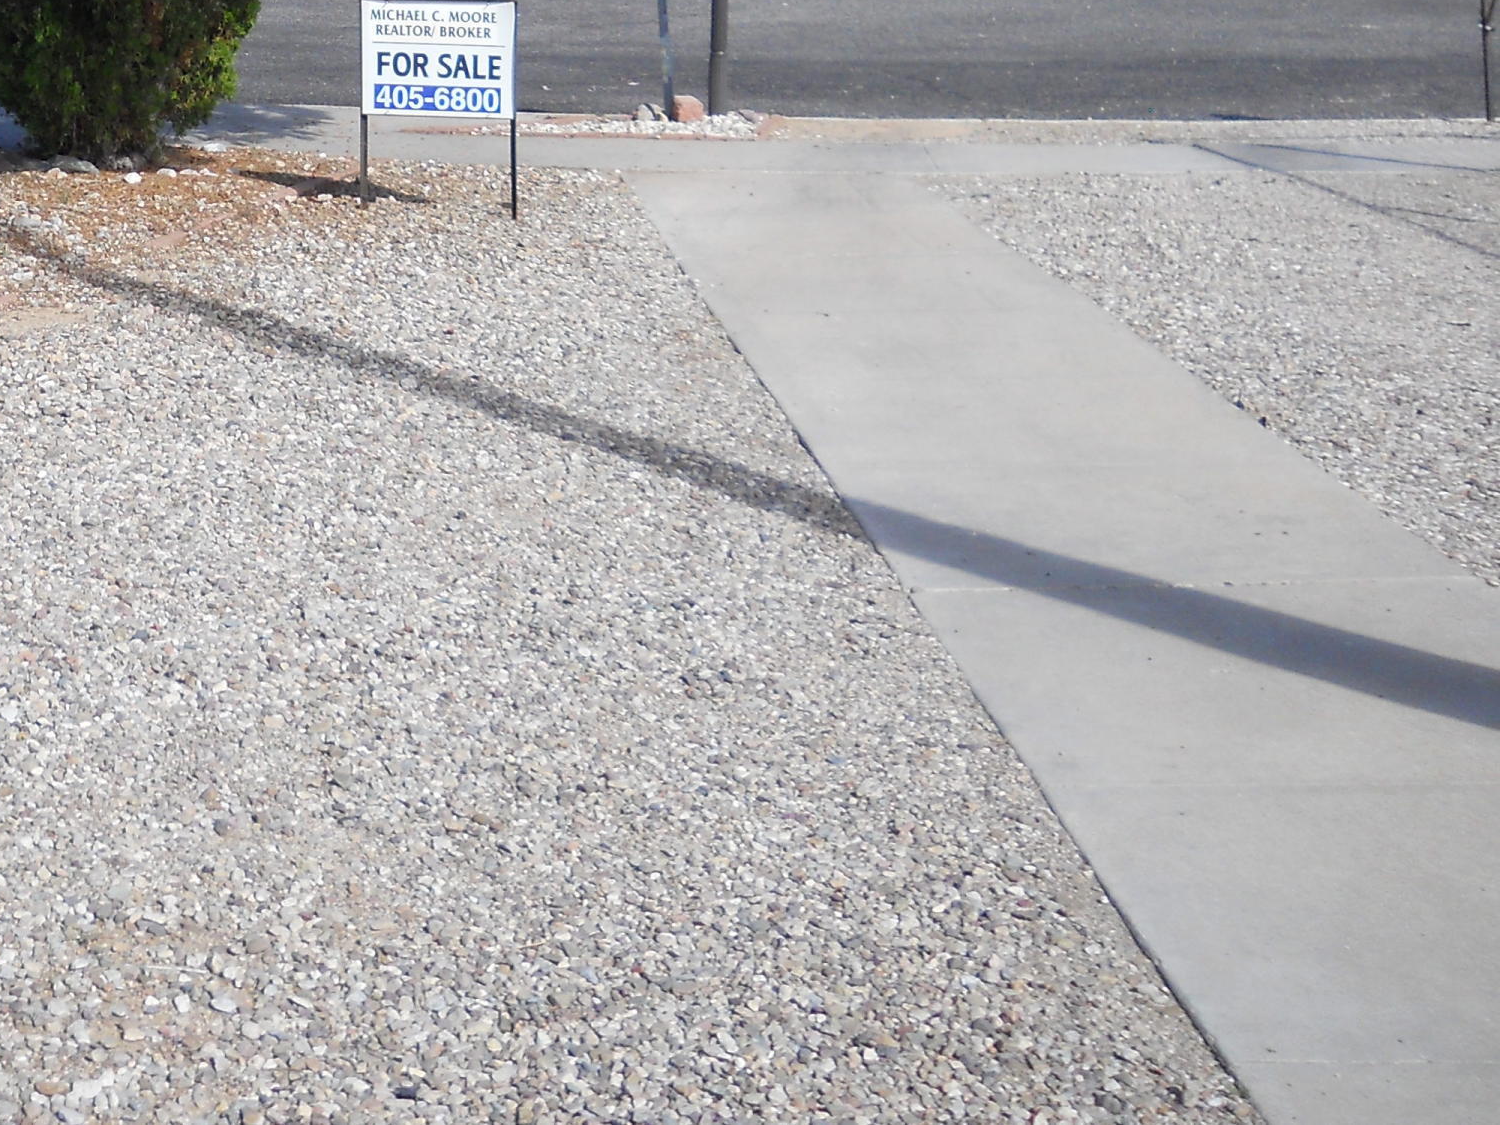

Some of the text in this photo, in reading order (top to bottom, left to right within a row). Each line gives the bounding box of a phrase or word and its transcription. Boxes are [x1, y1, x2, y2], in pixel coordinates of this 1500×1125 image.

[370, 9, 498, 24] MICHAEL C. MOORE
[439, 26, 492, 39] BROKER
[376, 51, 502, 80] FOR SALE
[376, 85, 500, 112] 405-6800
